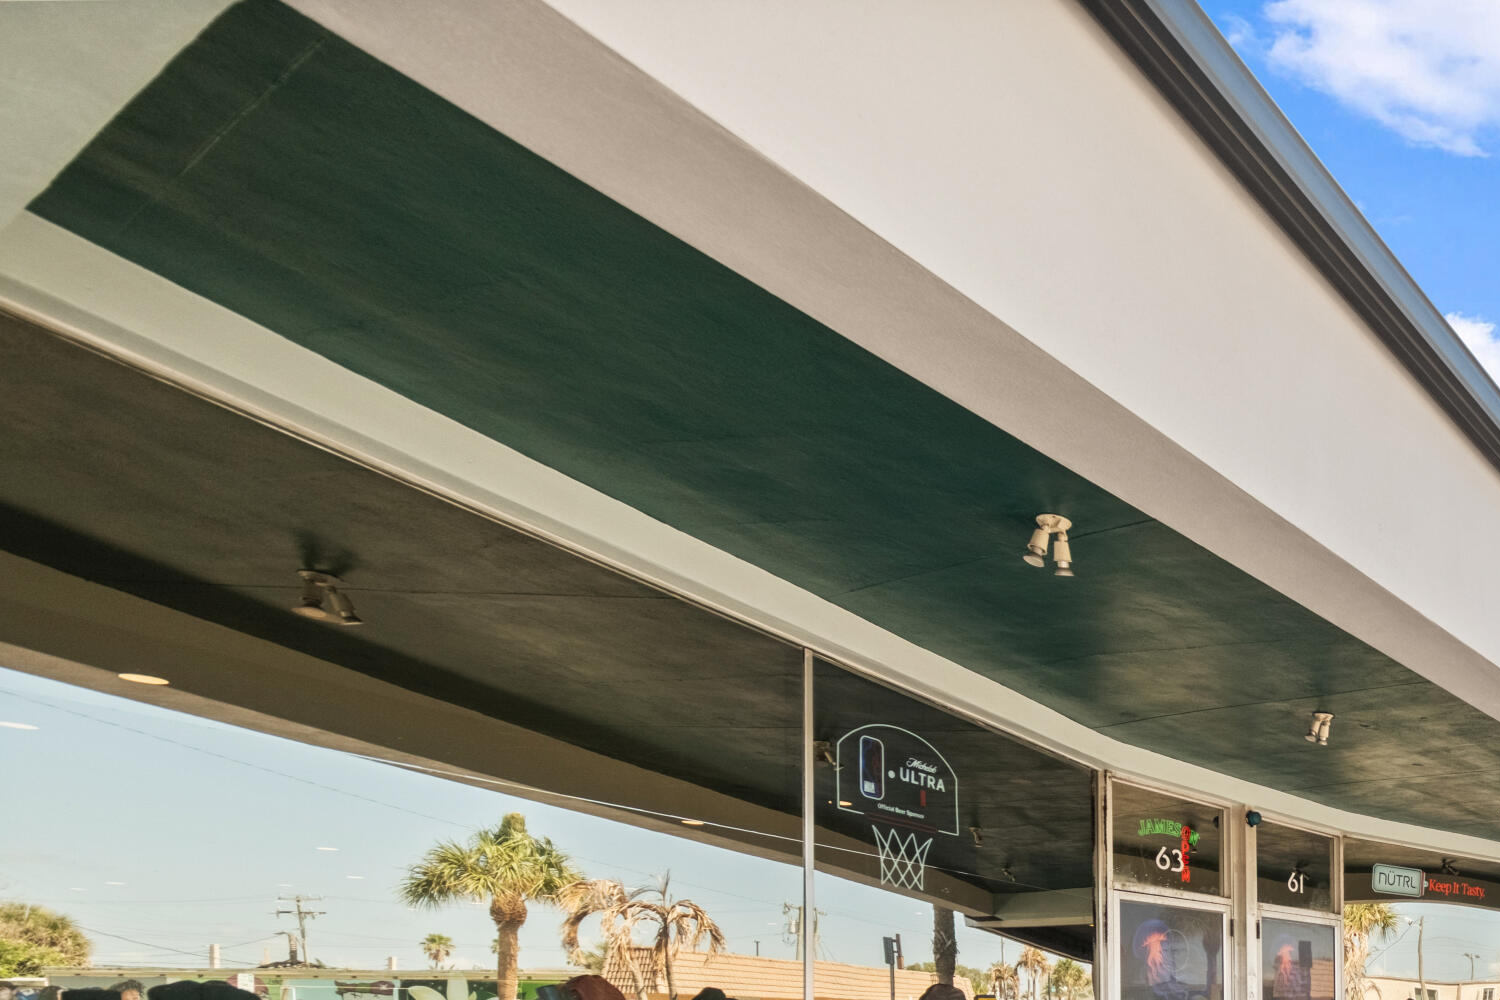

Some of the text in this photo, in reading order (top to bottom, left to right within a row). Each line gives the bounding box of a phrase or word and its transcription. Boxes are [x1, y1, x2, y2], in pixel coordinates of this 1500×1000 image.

[899, 766, 946, 793] ULTRA
[1138, 818, 1200, 846] JAMESN
[1156, 846, 1184, 873] 63
[1287, 871, 1304, 894] 61
[1428, 878, 1452, 896] Keep
[1452, 881, 1460, 895] It
